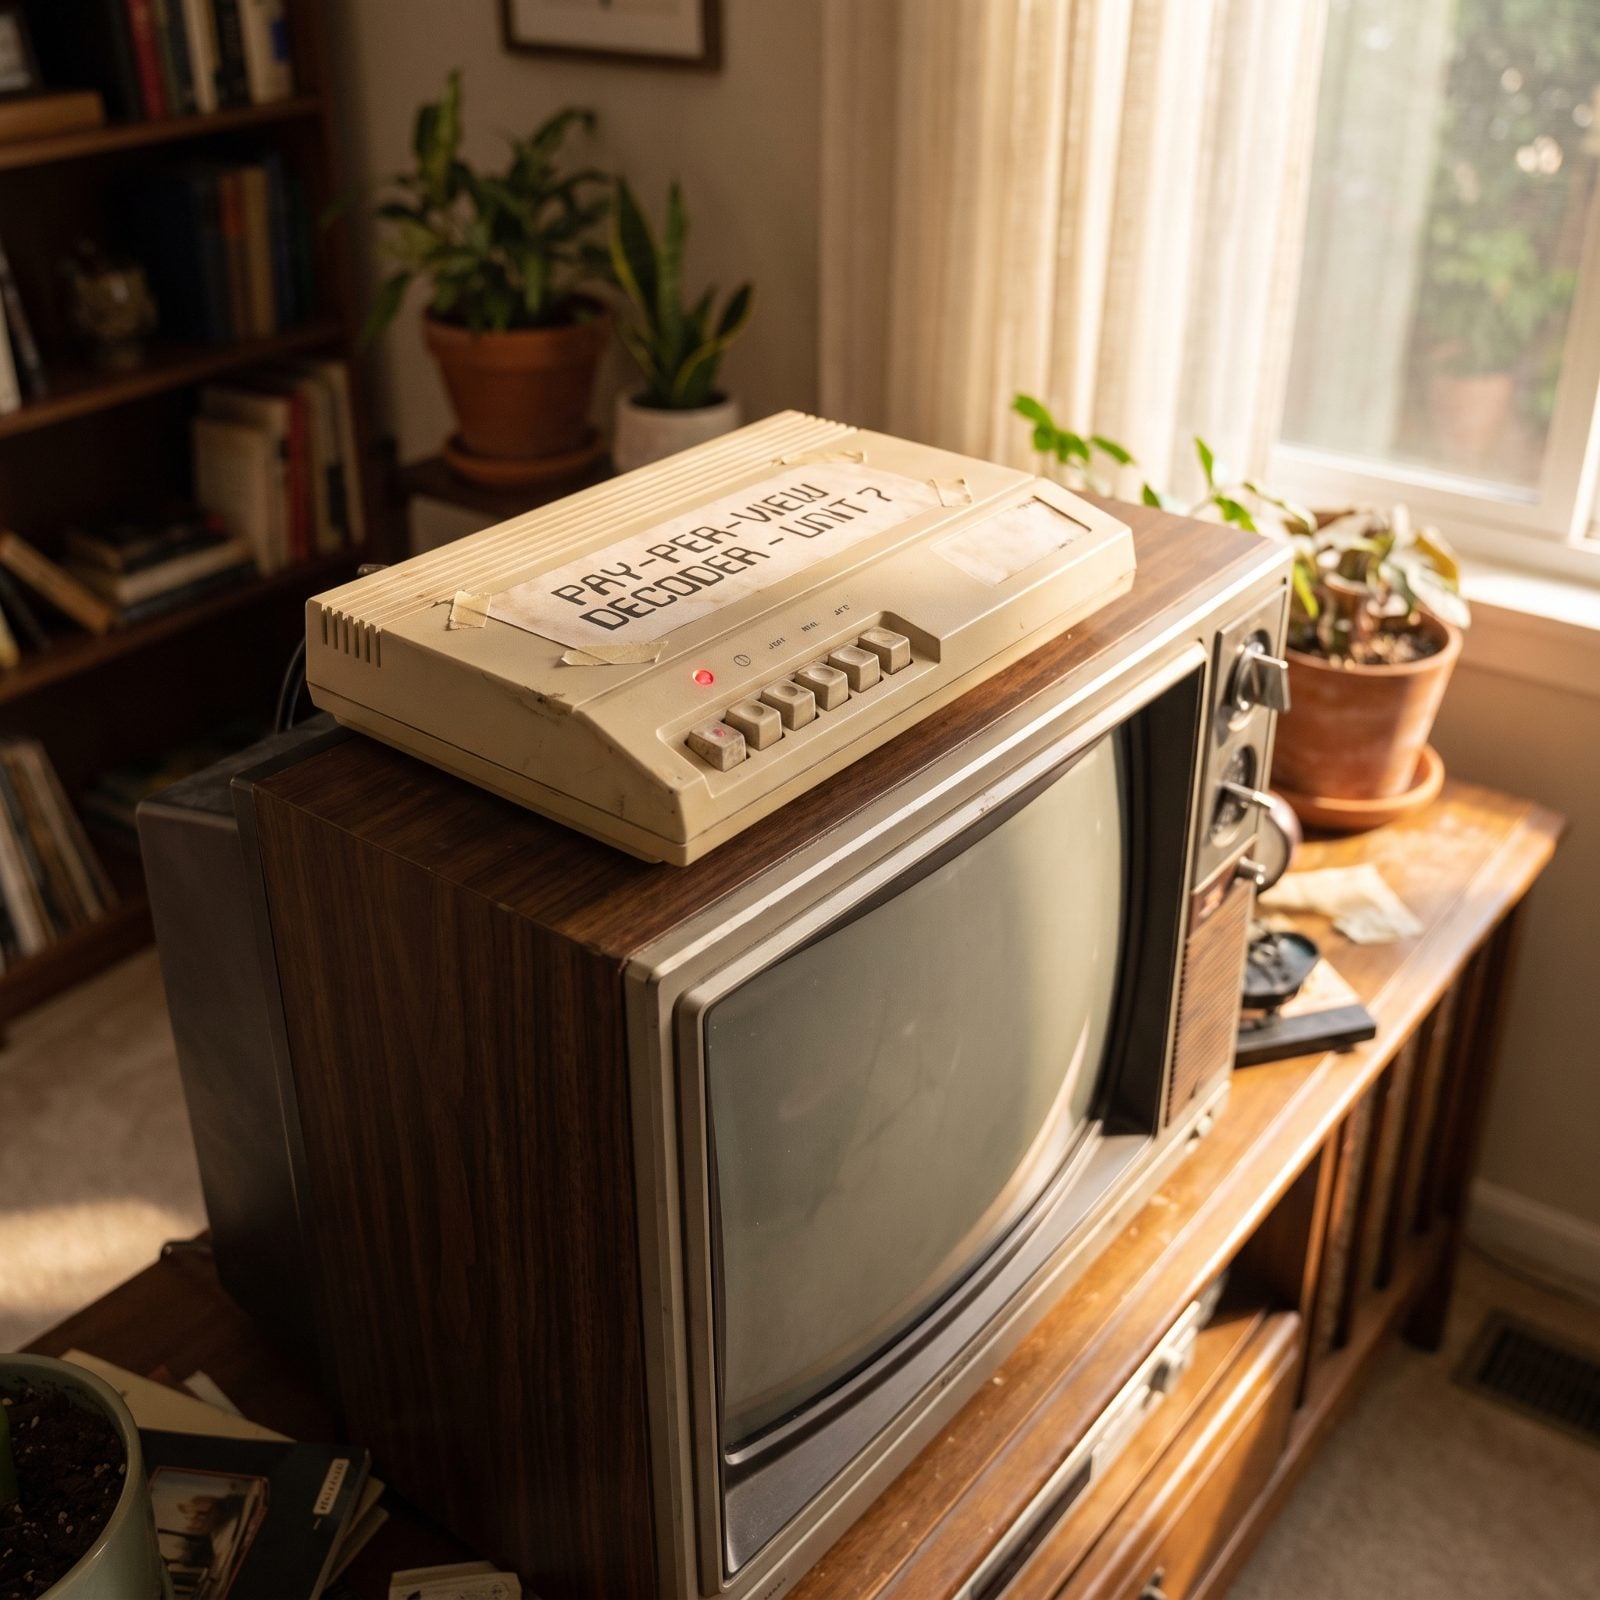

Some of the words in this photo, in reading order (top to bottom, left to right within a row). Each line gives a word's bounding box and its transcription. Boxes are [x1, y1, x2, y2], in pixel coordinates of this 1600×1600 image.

[550, 483, 829, 607] PAY-PER-VIEW
[578, 546, 771, 632] DECODER
[779, 498, 868, 539] UNIT
